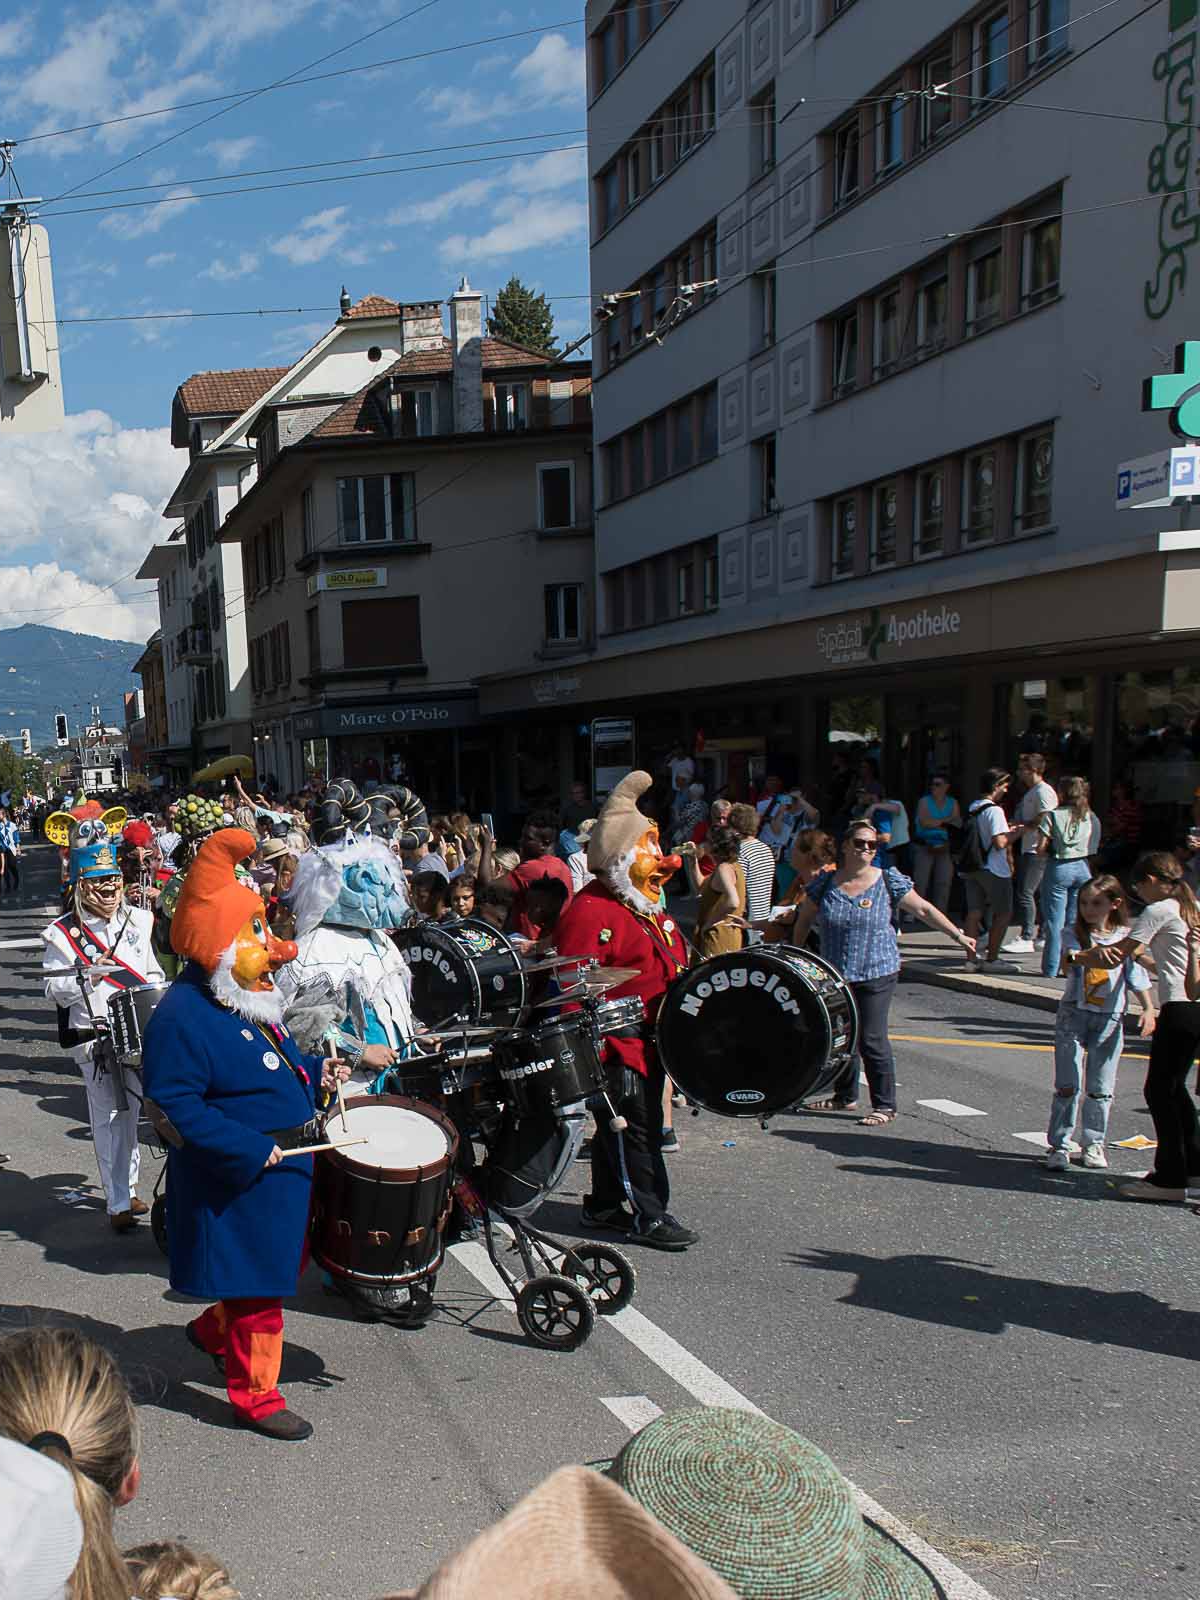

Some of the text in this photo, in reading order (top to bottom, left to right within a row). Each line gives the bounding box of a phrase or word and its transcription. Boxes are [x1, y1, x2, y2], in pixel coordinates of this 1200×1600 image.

[1175, 461, 1192, 480] P
[887, 605, 961, 647] Apotheke
[340, 706, 450, 728] Marc O'Polo
[680, 968, 800, 1017] Noggeler
[730, 1091, 760, 1102] EVANS
